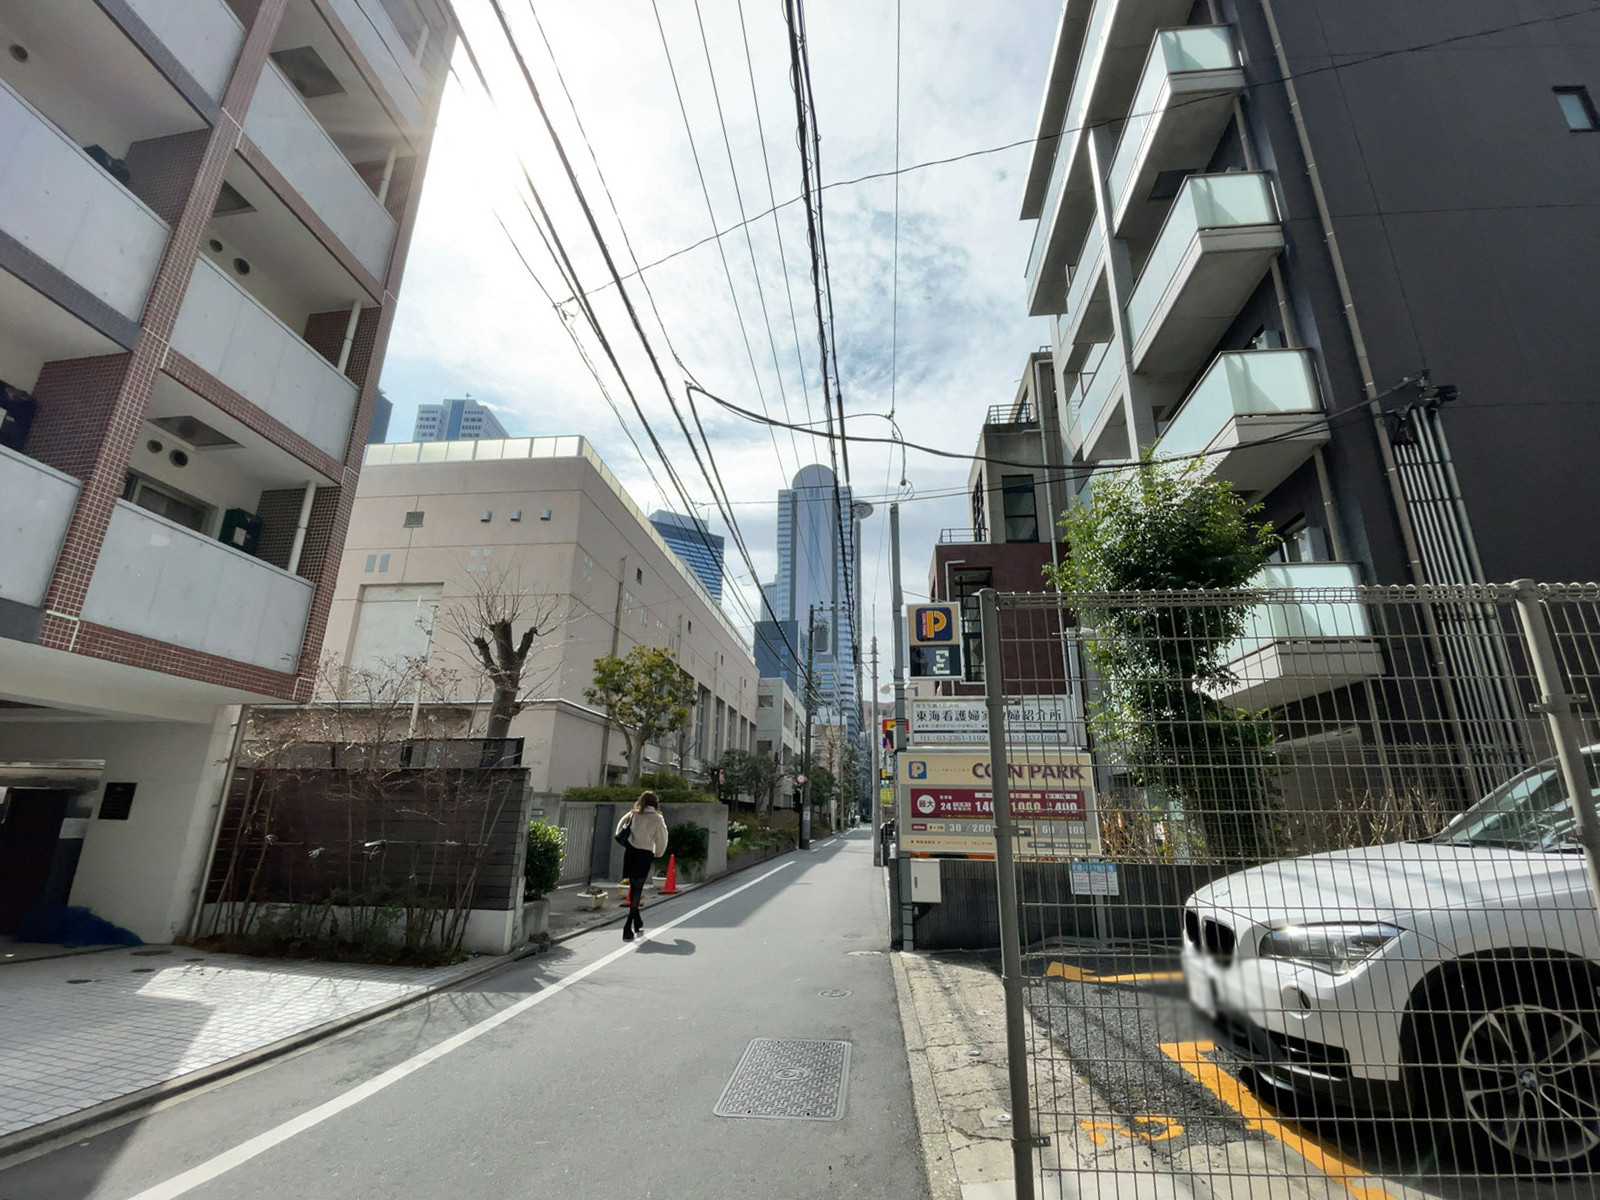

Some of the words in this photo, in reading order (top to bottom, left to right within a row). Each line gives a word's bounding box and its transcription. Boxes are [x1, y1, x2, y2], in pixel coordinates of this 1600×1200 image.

[1030, 764, 1085, 780] PARK
[919, 799, 934, 808] 最大
[940, 802, 952, 811] 24
[949, 823, 962, 832] 30
